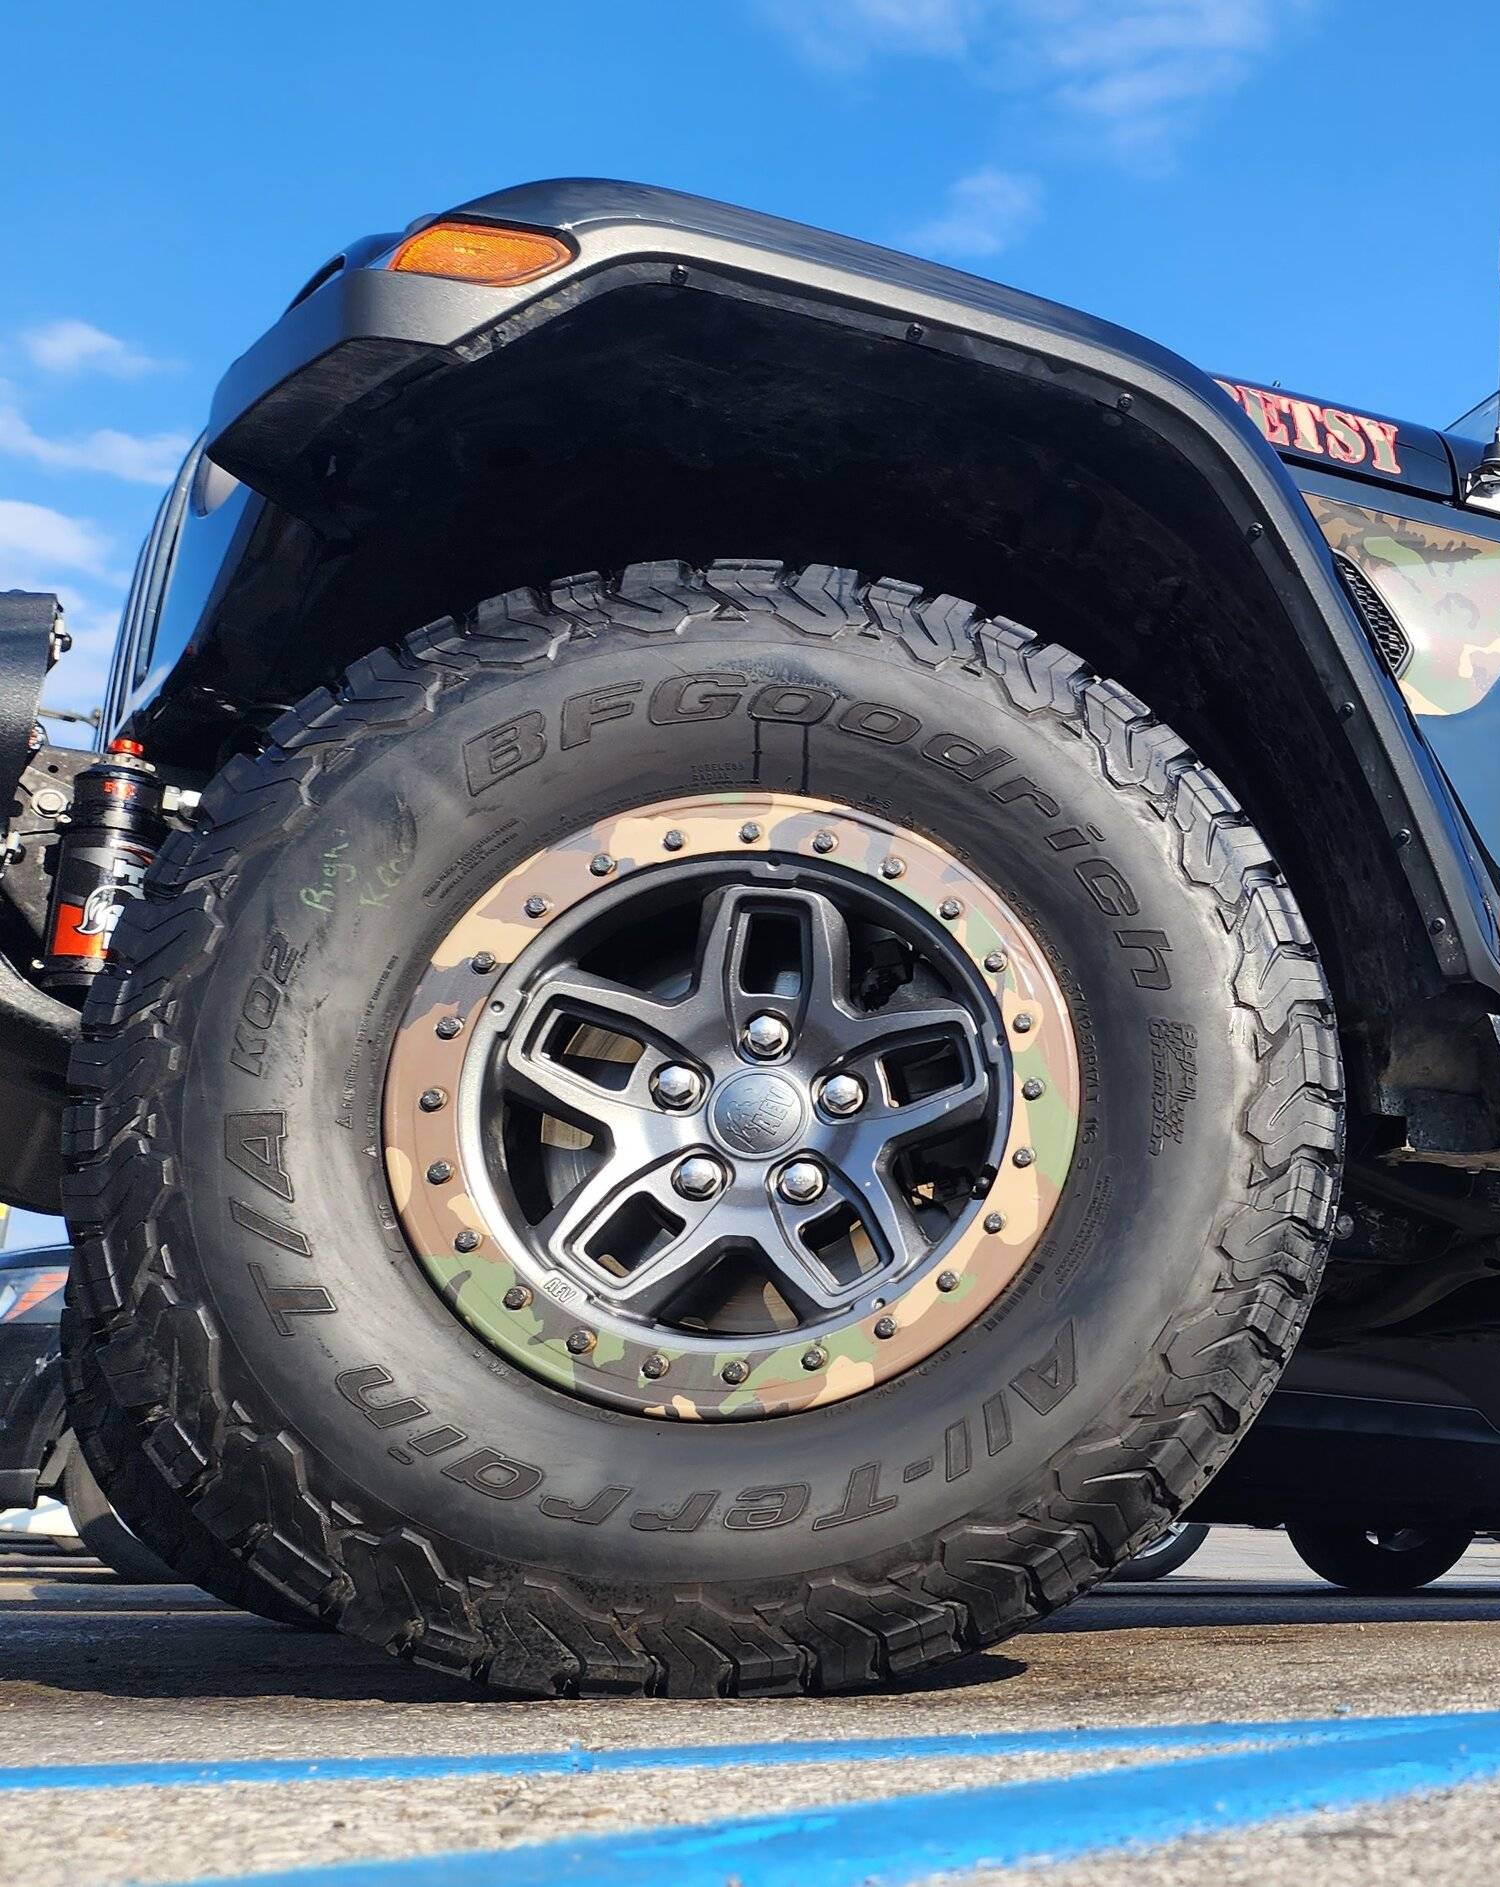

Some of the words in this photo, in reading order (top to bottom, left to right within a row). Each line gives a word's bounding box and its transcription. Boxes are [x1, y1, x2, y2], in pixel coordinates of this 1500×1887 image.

[1213, 379, 1402, 475] ETSY
[462, 672, 1173, 991] BFGoodrich
[231, 928, 299, 1077] KO2
[224, 1108, 338, 1337] T/A
[543, 1277, 578, 1303] AEV
